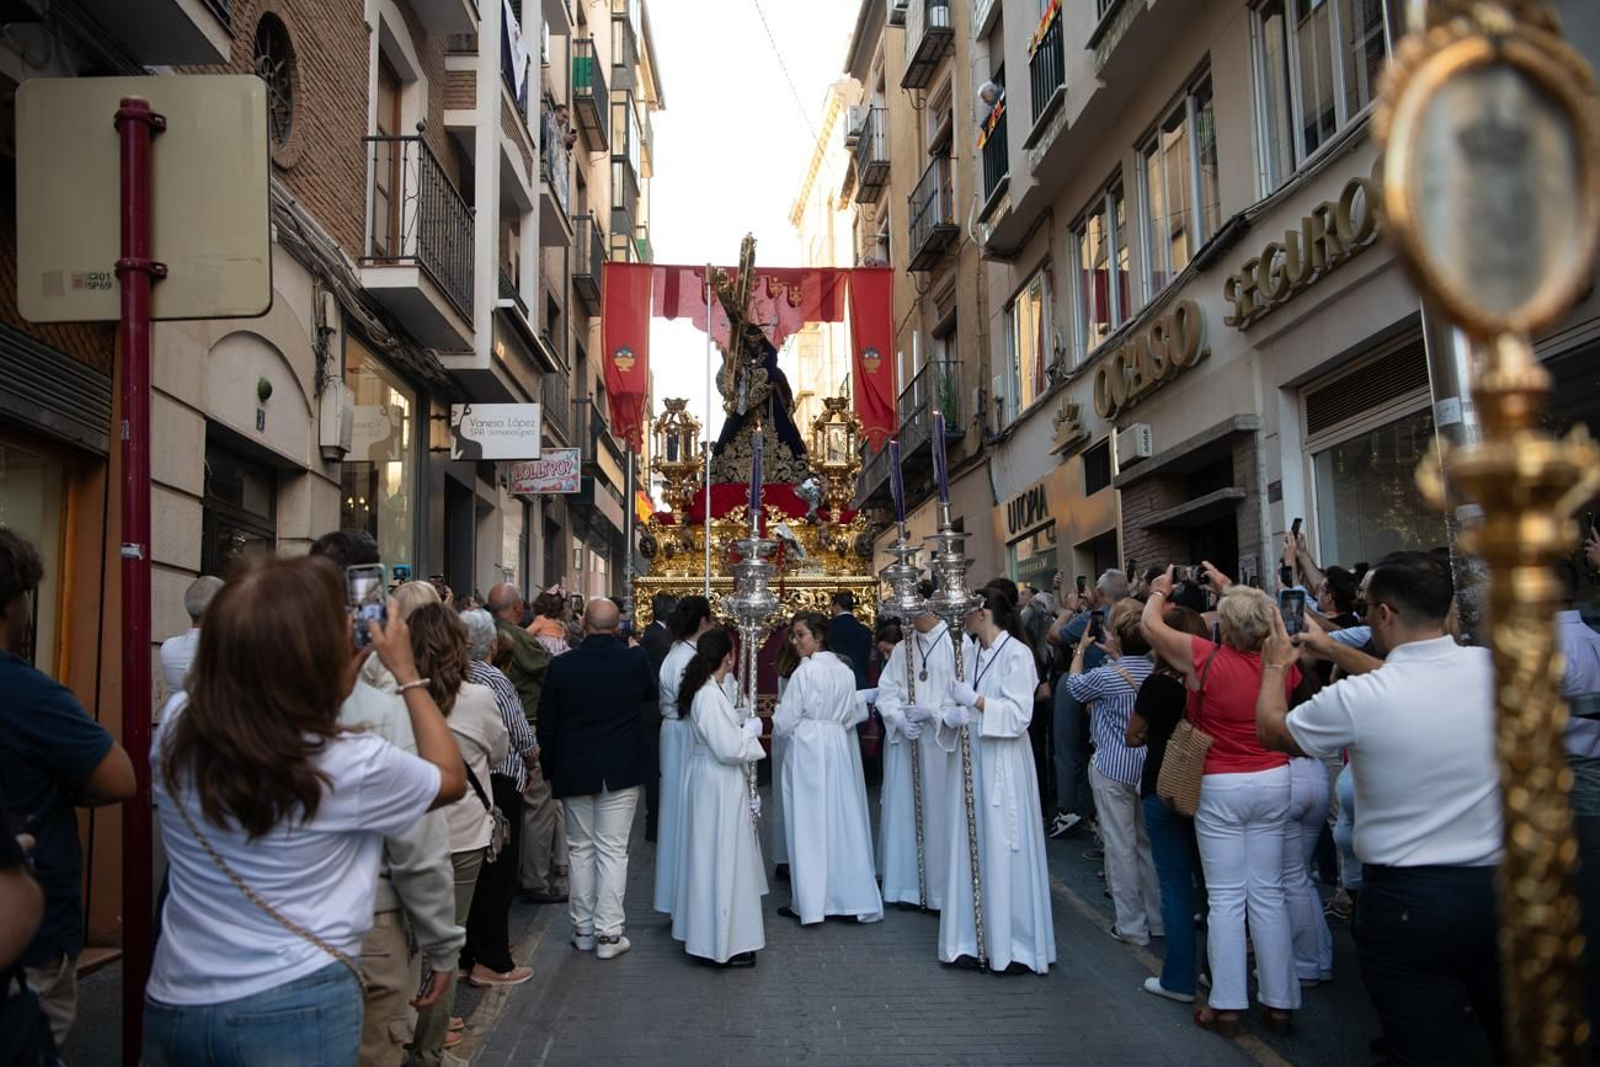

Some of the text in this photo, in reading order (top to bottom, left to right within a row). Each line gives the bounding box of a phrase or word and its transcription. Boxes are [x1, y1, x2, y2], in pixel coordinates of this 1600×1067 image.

[1093, 299, 1207, 422] OCASO
[469, 417, 535, 430] Vanesa López
[1007, 483, 1049, 535] UTOPIA
